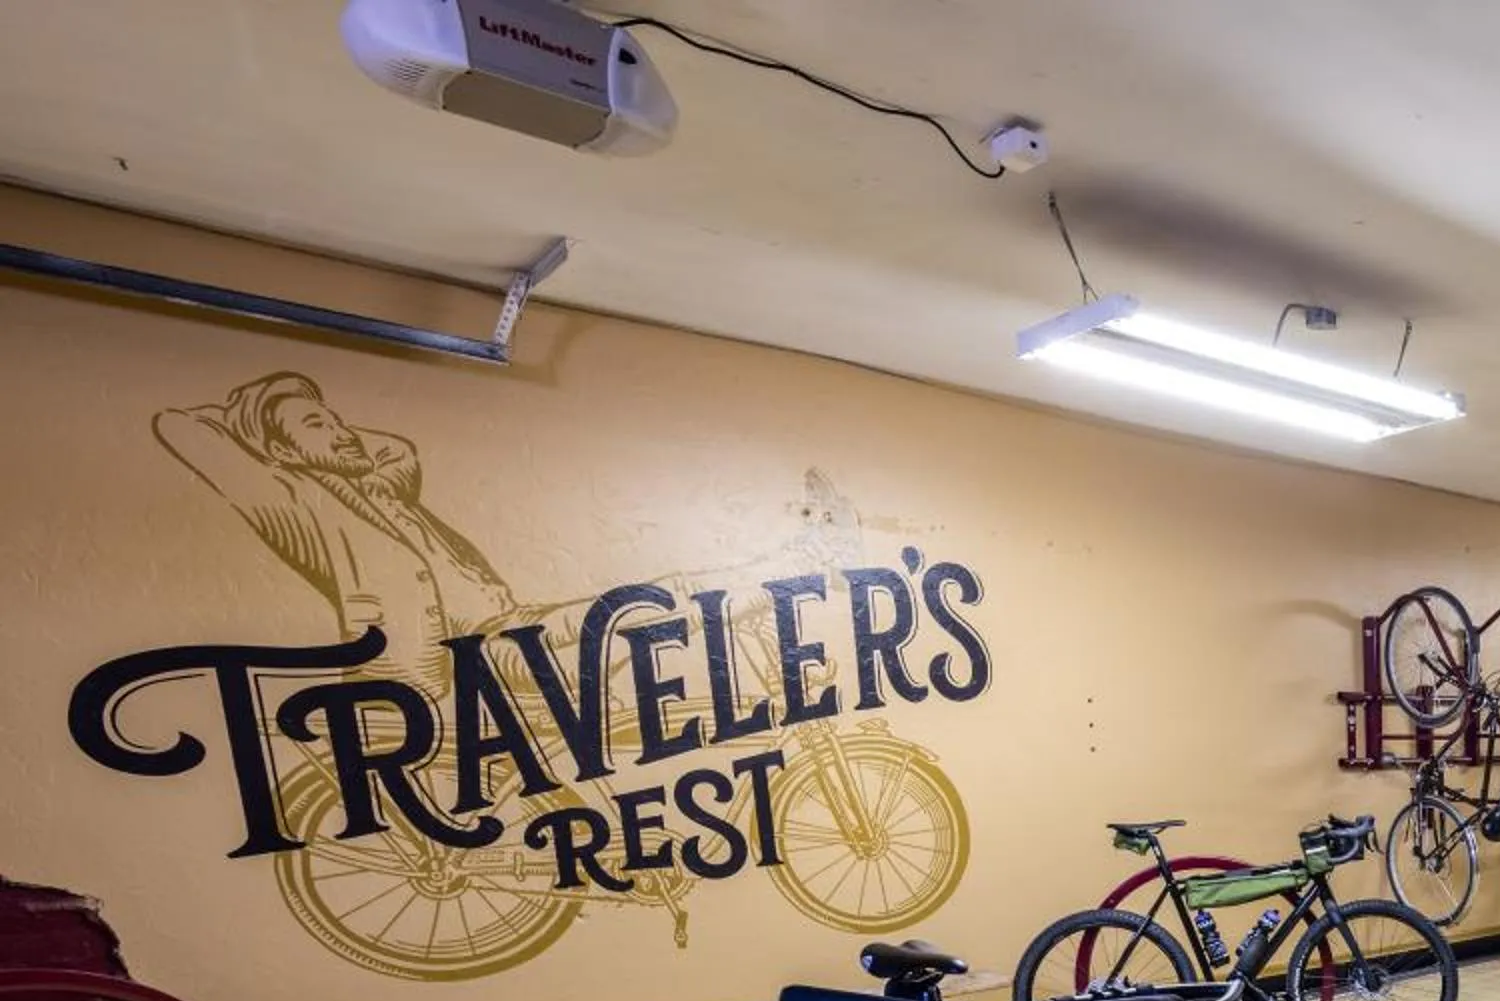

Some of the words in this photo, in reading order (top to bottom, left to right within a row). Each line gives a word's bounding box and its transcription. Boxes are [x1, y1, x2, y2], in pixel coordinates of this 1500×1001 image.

[479, 15, 597, 66] LiftMaster
[68, 545, 992, 858] TRAVELER'S
[524, 749, 786, 892] REST
